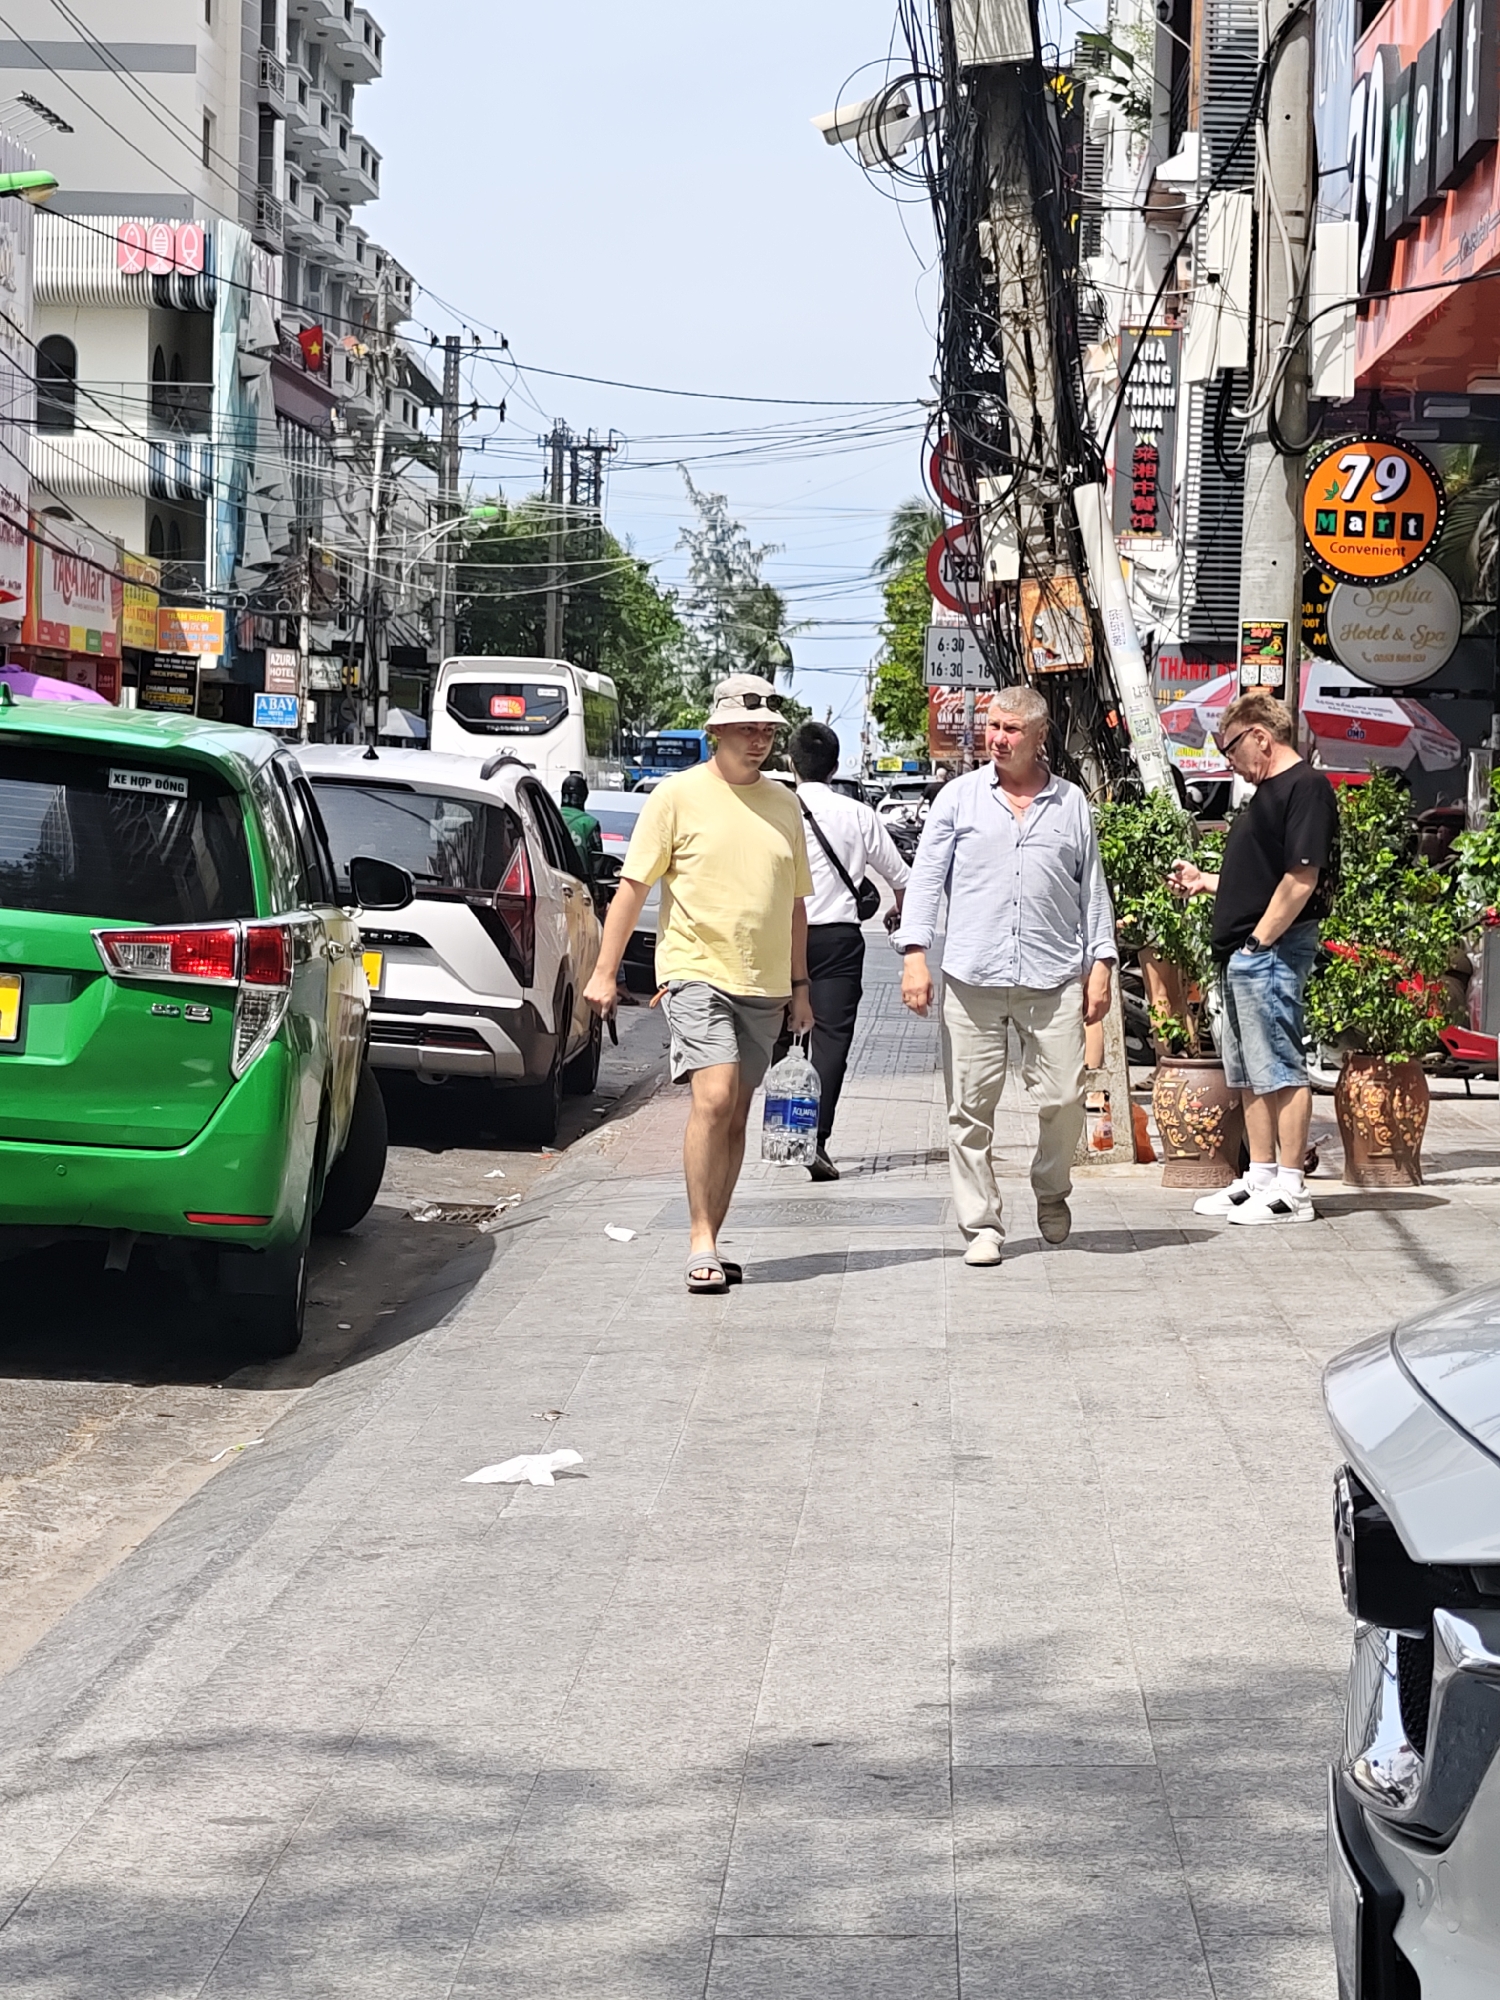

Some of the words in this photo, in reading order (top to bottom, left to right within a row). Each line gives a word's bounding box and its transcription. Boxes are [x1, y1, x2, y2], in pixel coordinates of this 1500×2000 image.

[1386, 2, 1477, 212] Mart
[1130, 409, 1163, 429] NHA
[1338, 454, 1408, 502] 79
[1316, 512, 1418, 537] Mart
[1330, 541, 1406, 557] Convenient
[80, 563, 105, 603] Mart
[1353, 578, 1434, 618] Sophia
[937, 637, 965, 653] 6:30
[1340, 622, 1391, 642] Hotel
[1391, 627, 1406, 642] &
[1410, 624, 1448, 650] Spa
[270, 653, 296, 667] AZURA
[270, 667, 295, 678] HOTEL
[930, 661, 963, 678] 16:30
[1347, 729, 1366, 739] OMO
[113, 773, 128, 785] XE
[130, 775, 152, 790] HỢP
